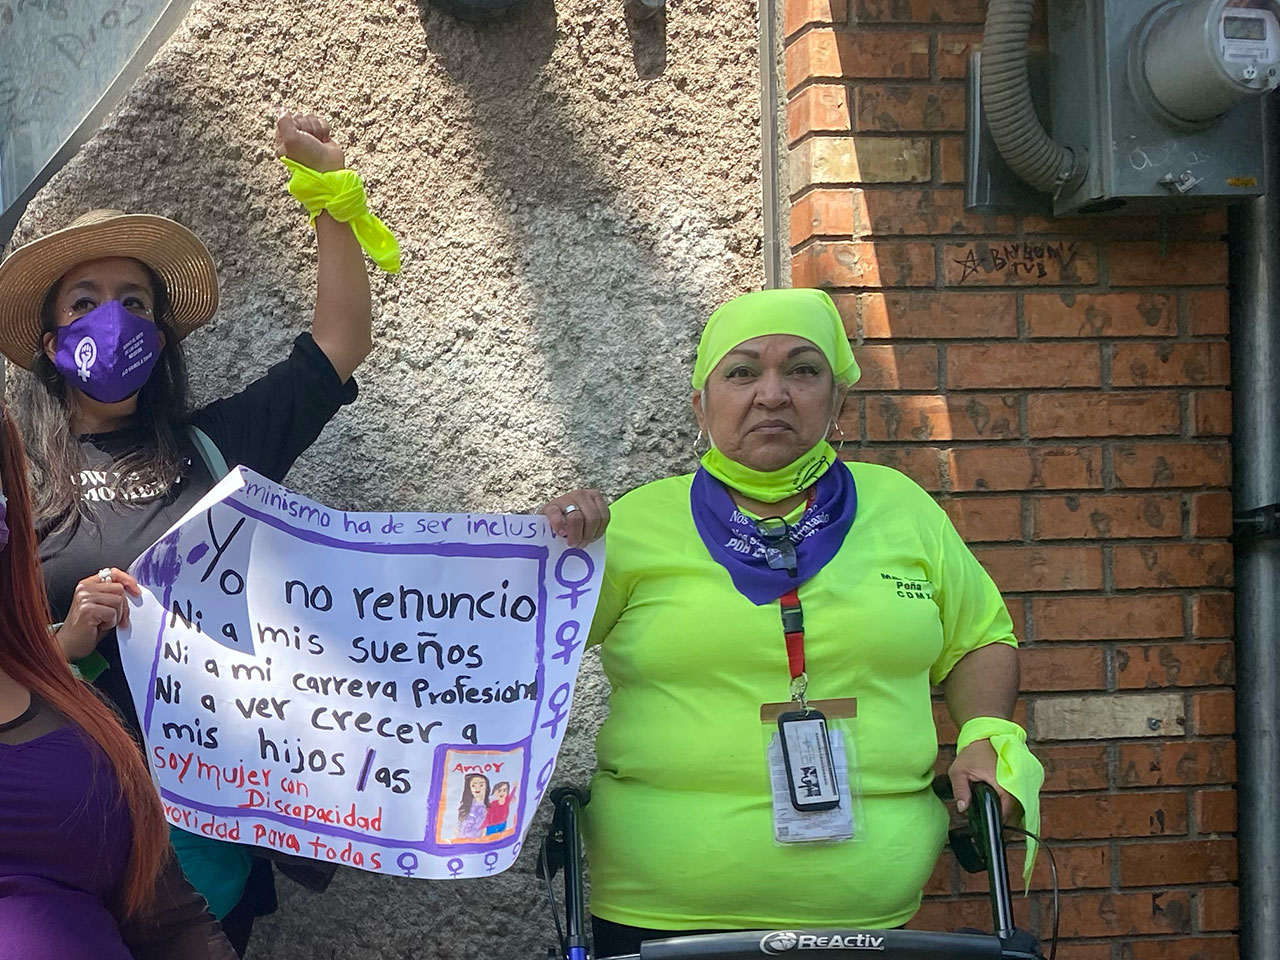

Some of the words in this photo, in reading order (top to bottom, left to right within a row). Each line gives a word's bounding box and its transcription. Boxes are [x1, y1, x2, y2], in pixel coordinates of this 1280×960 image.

[344, 513, 371, 534] ha
[382, 515, 404, 535] de
[416, 516, 453, 534] ser
[200, 509, 245, 597] Yo
[285, 579, 332, 611] no
[353, 580, 537, 623] renuncio
[168, 599, 203, 635] Ni
[222, 621, 239, 642] a
[257, 621, 324, 655] mis
[348, 632, 484, 670] sueños
[163, 640, 189, 665] Ni
[204, 658, 220, 677] a
[231, 657, 273, 682] mi
[292, 672, 398, 702] carrera
[155, 676, 181, 705] Ni
[203, 693, 216, 713] a
[235, 694, 293, 722] ver
[311, 706, 442, 745] crecer
[462, 723, 478, 745] a
[162, 718, 218, 749] mis
[259, 727, 346, 774] hijos
[238, 788, 383, 832] Discapacidad
[280, 776, 309, 798] con
[308, 837, 382, 869] todas
